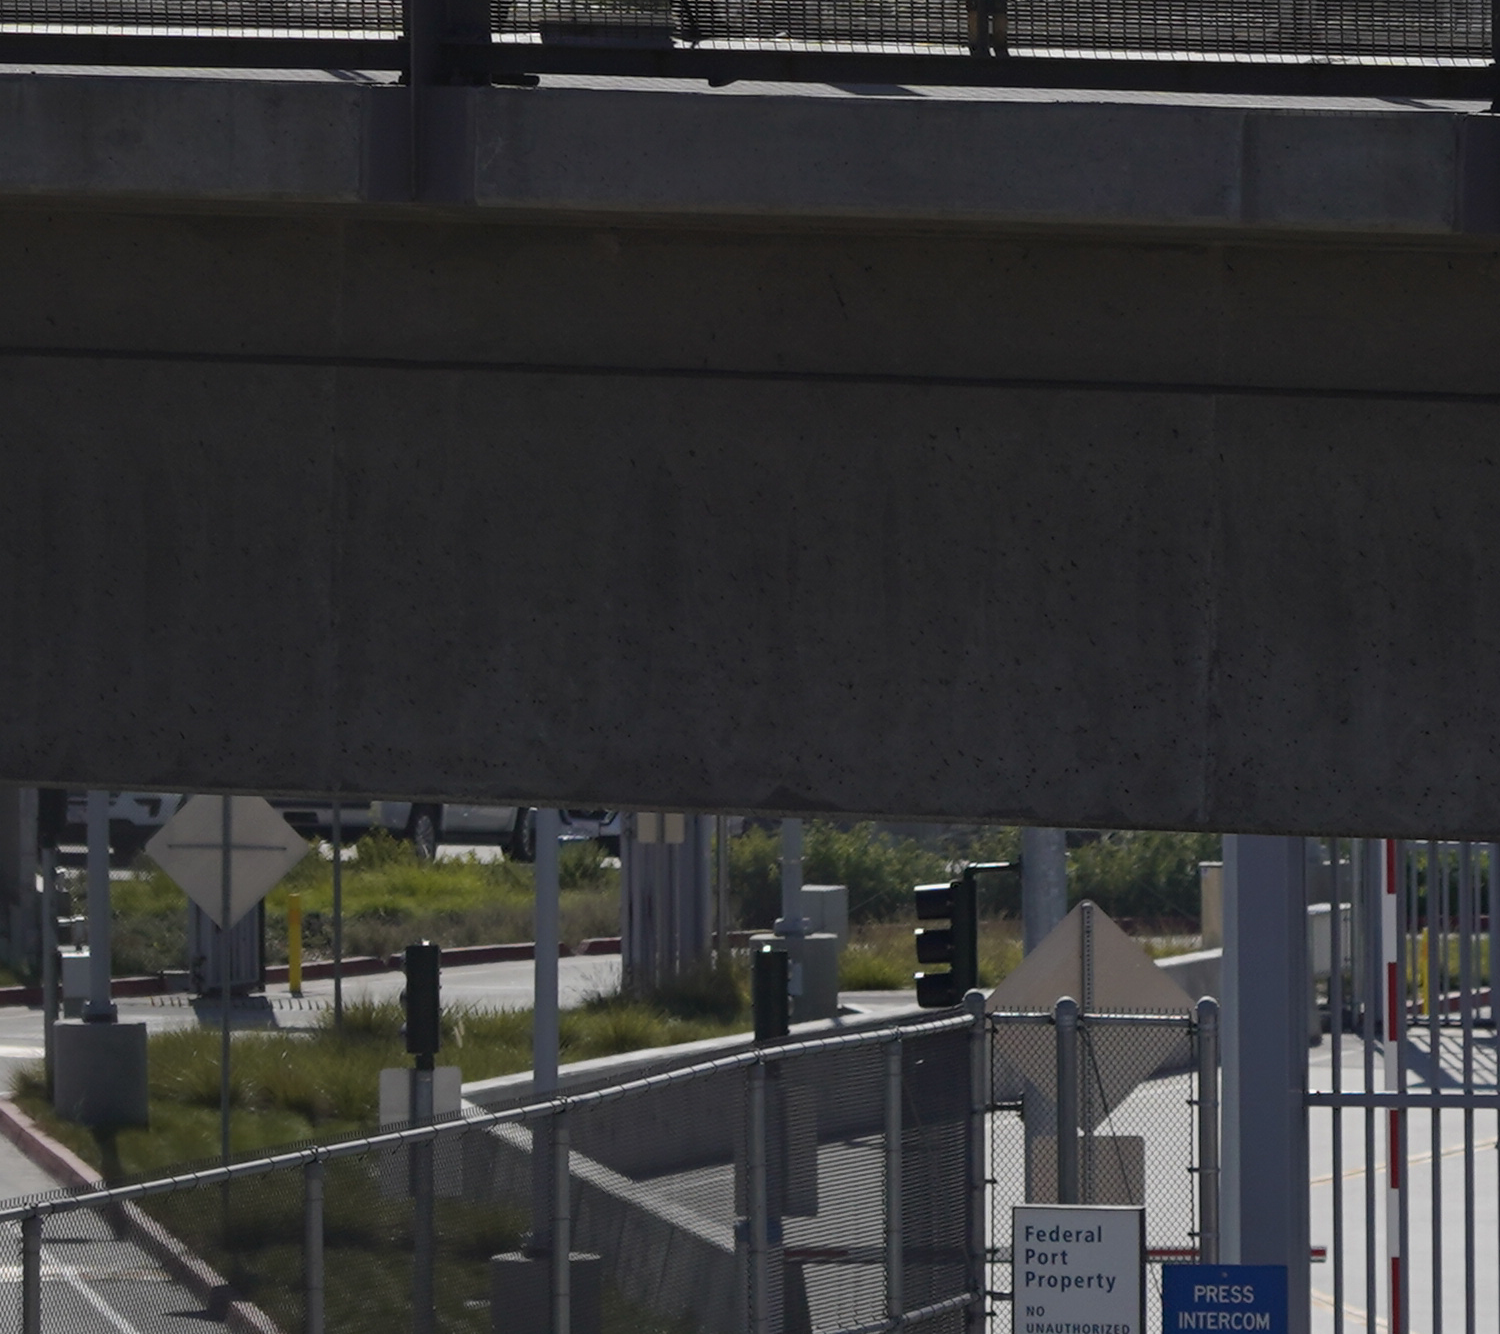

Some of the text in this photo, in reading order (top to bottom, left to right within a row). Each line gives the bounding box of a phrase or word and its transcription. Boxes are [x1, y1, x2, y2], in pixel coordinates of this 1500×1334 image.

[1025, 1225, 1102, 1243] Federal
[1025, 1248, 1068, 1265] Port
[1025, 1271, 1116, 1293] Property
[1194, 1285, 1255, 1304] PRESS
[1026, 1306, 1045, 1317] NO
[1026, 1323, 1130, 1334] UNAUTHORIZED
[1178, 1312, 1270, 1331] INTERCOM
